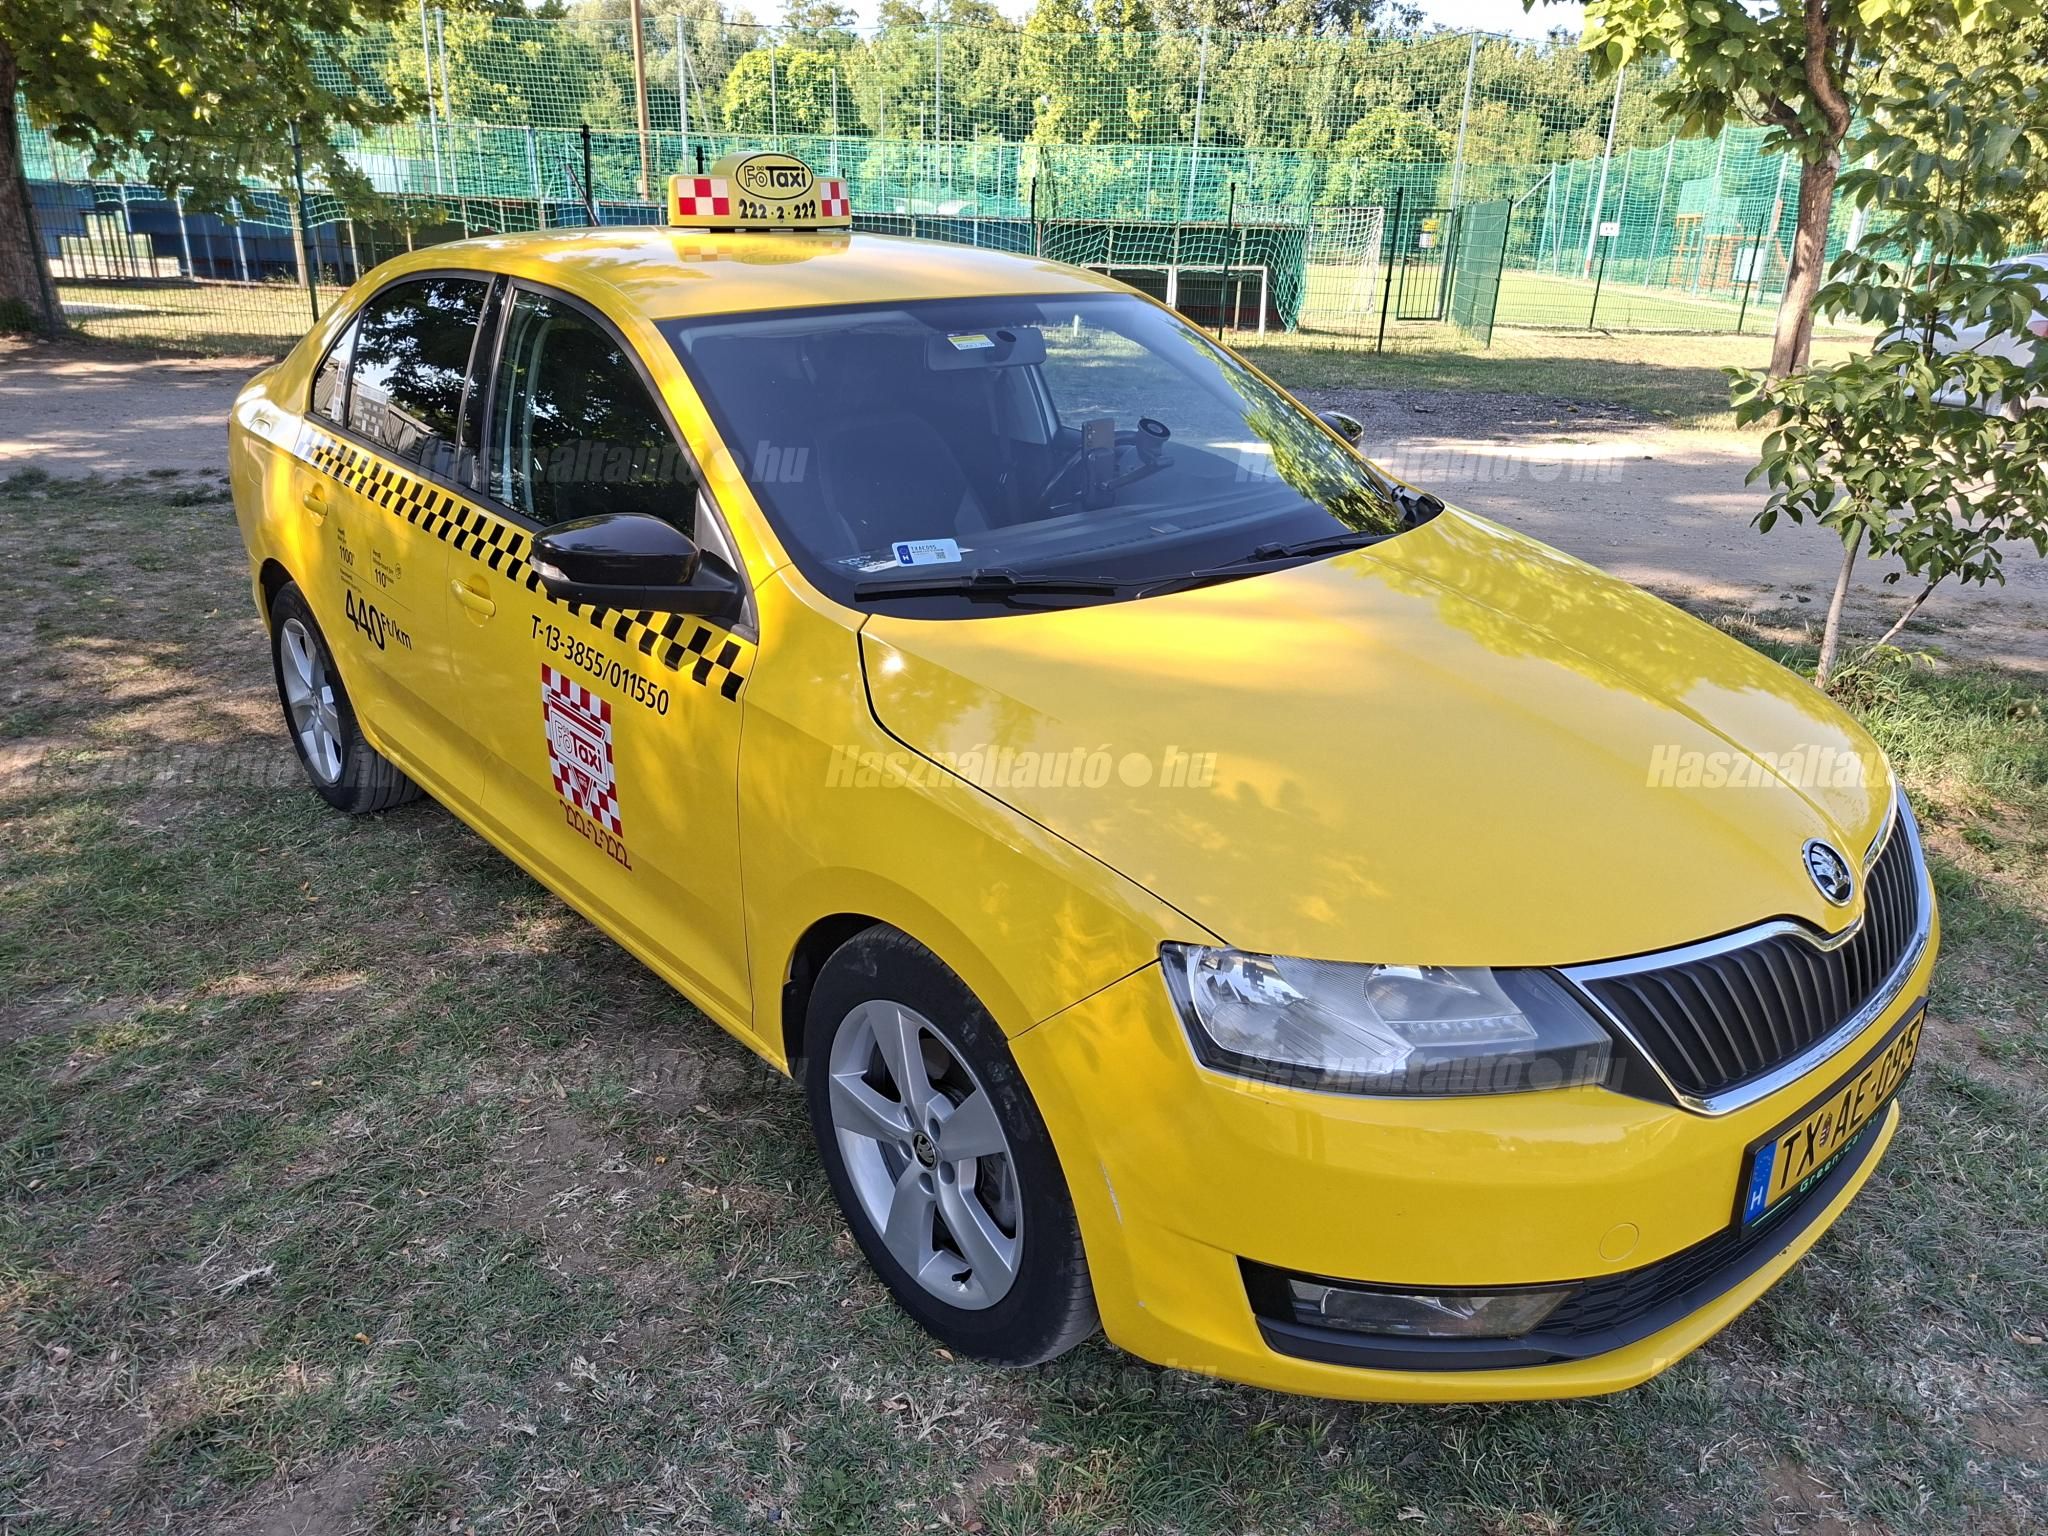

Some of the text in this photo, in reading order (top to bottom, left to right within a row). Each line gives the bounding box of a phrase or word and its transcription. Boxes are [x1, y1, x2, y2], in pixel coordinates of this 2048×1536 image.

[345, 588, 385, 651] 440
[531, 614, 669, 716] T-13-3855/011550
[1780, 1112, 1823, 1190] TX
[1750, 1186, 1764, 1211] H
